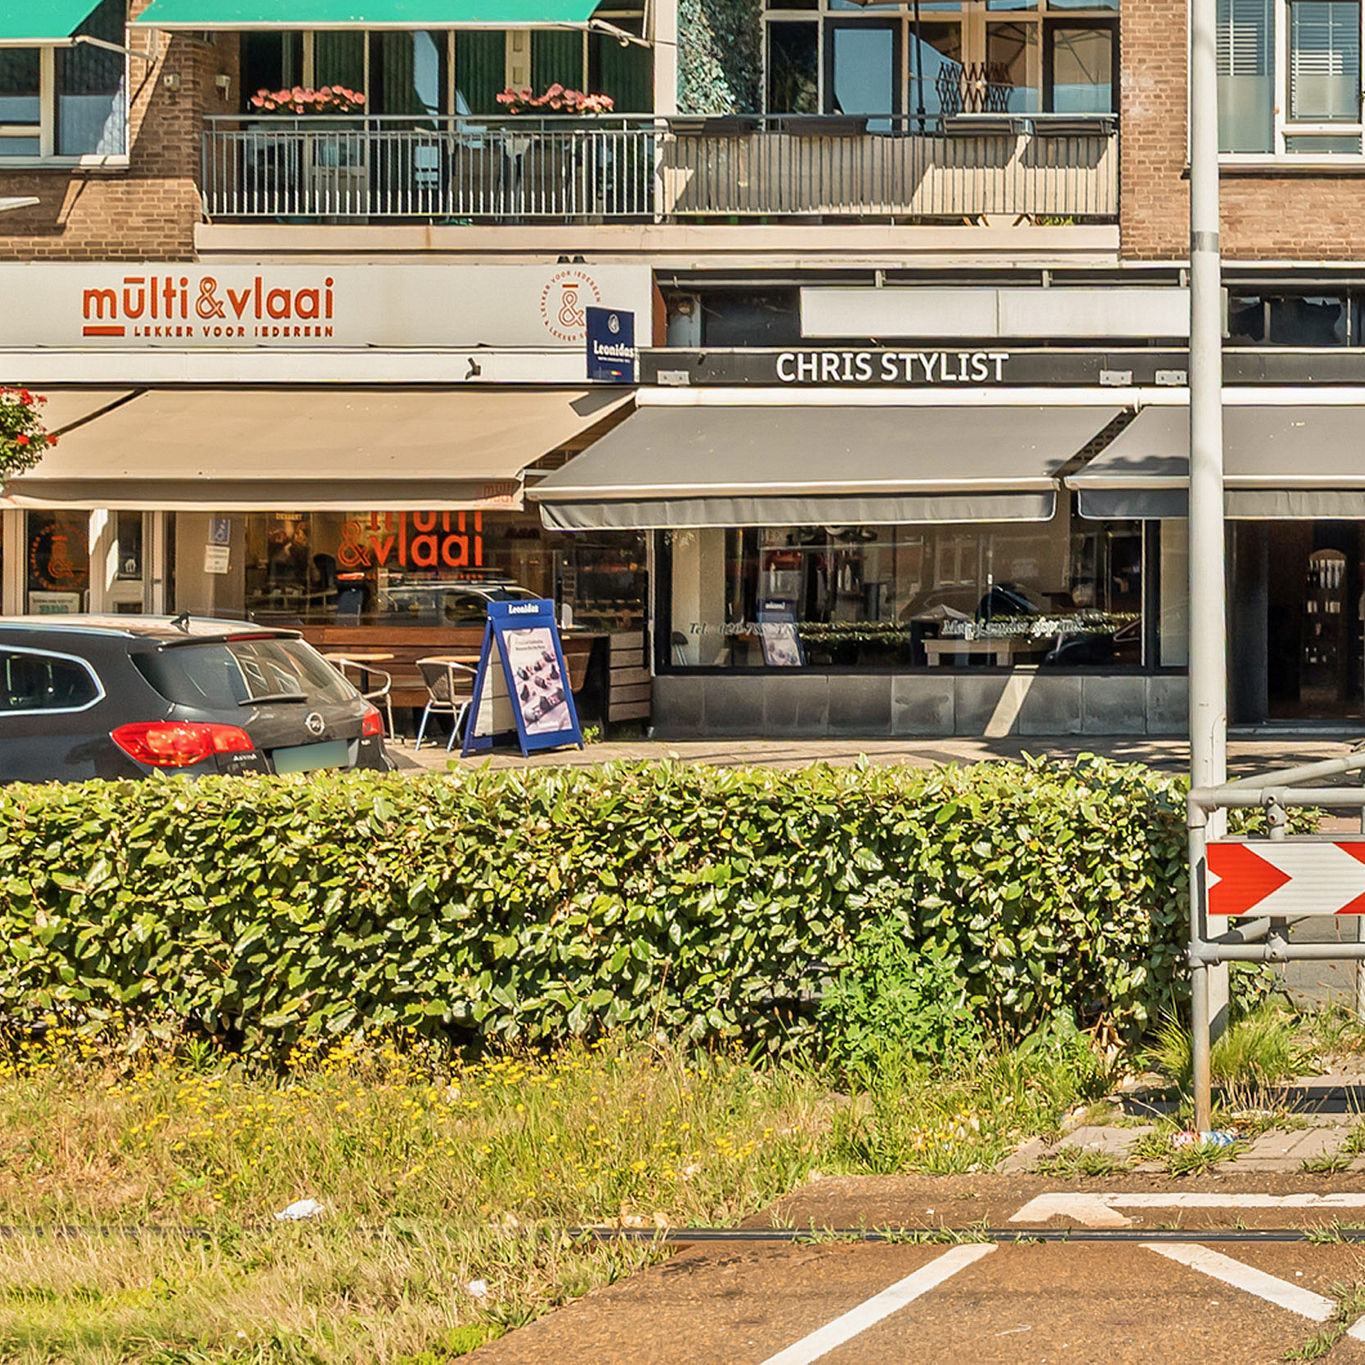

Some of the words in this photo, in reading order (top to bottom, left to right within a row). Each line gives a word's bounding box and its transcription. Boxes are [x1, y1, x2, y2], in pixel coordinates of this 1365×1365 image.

[134, 326, 194, 337] LEKKER
[203, 326, 245, 337] VOOR
[255, 326, 333, 337] IEDEREEN
[593, 339, 635, 359] Leonidas
[776, 352, 873, 381] CHRIS
[880, 352, 1010, 381] STYLIST
[508, 603, 539, 614] Leonidas
